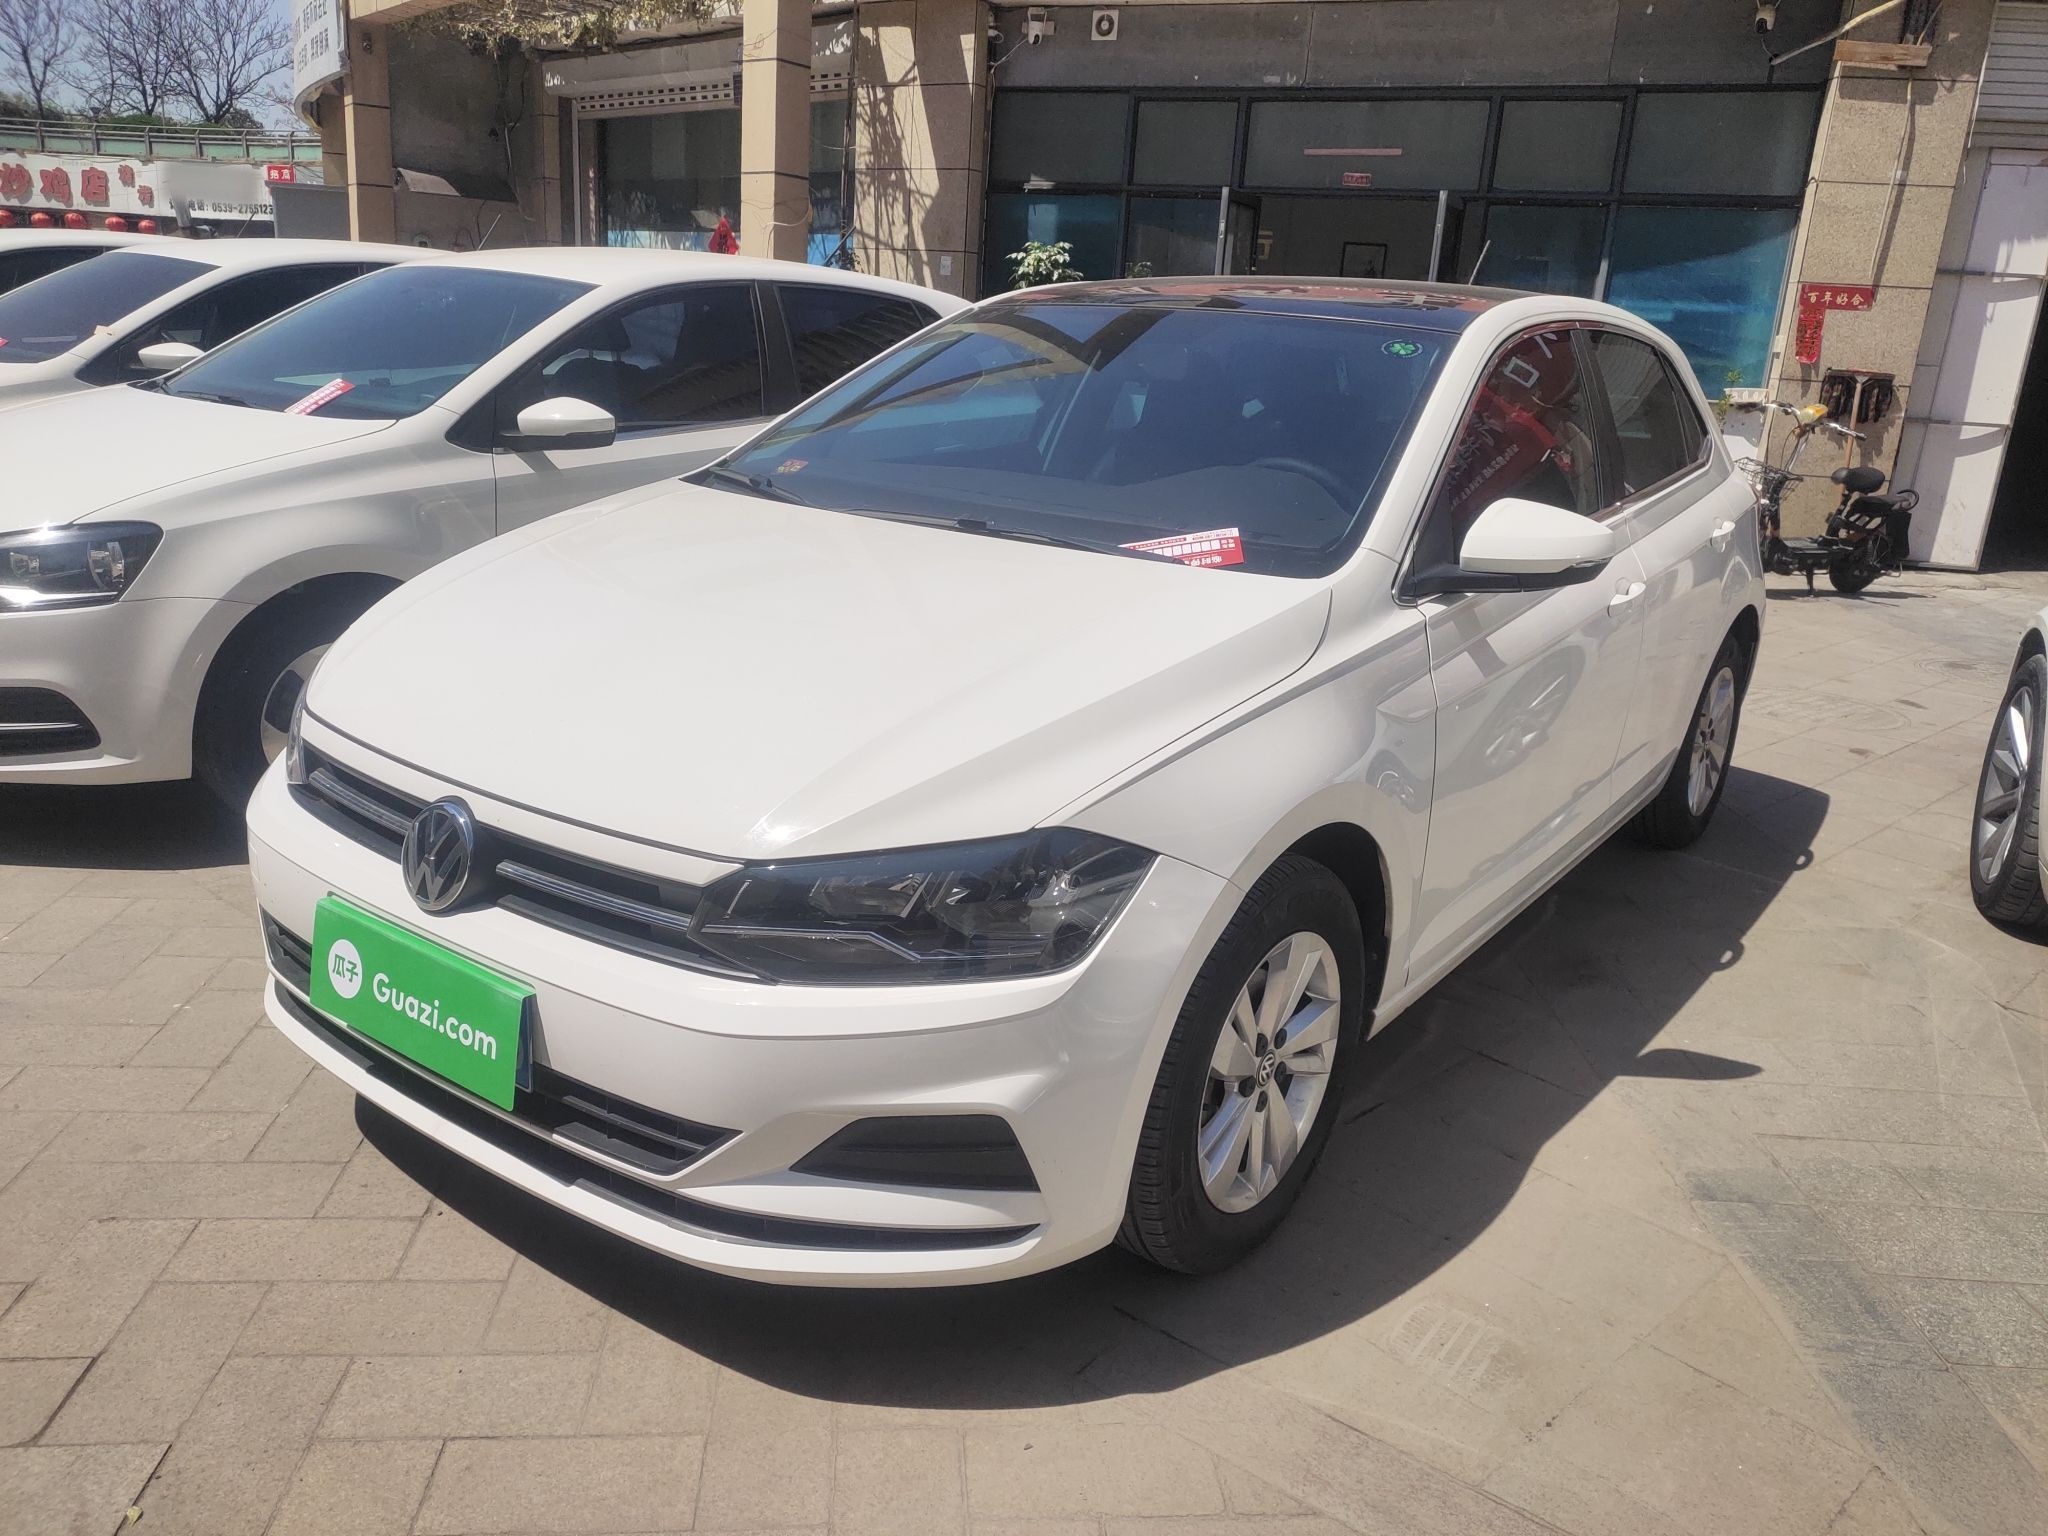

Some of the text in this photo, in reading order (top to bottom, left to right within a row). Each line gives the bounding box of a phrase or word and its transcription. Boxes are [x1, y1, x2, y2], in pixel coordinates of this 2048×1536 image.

[1807, 291, 1865, 307] 百年好合
[331, 953, 359, 984] 瓜子
[372, 972, 497, 1061] Guazi.com
